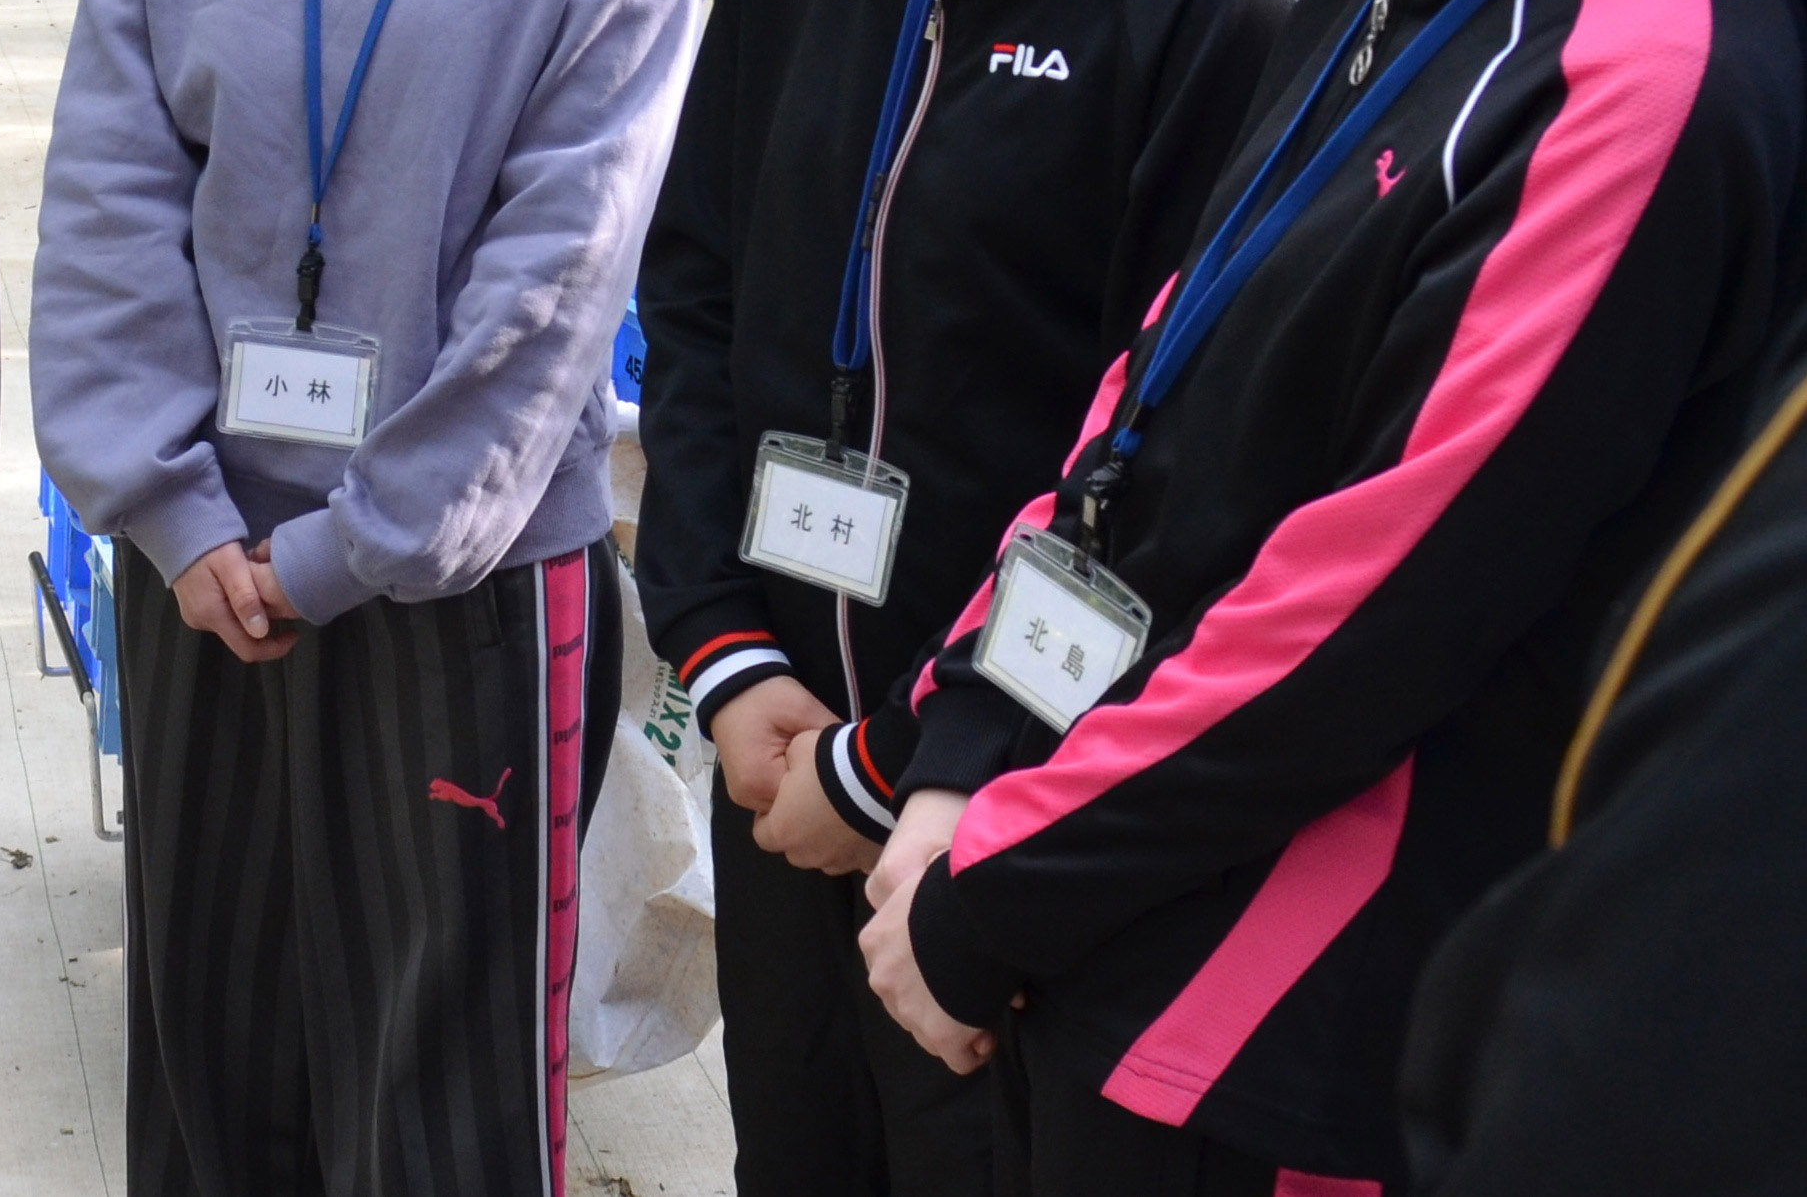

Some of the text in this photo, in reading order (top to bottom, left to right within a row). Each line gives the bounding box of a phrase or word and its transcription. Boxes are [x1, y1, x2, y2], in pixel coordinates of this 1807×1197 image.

[989, 43, 1069, 81] FILA
[265, 374, 331, 404] 小林
[790, 503, 854, 545] 北村
[1024, 617, 1085, 682] 北島
